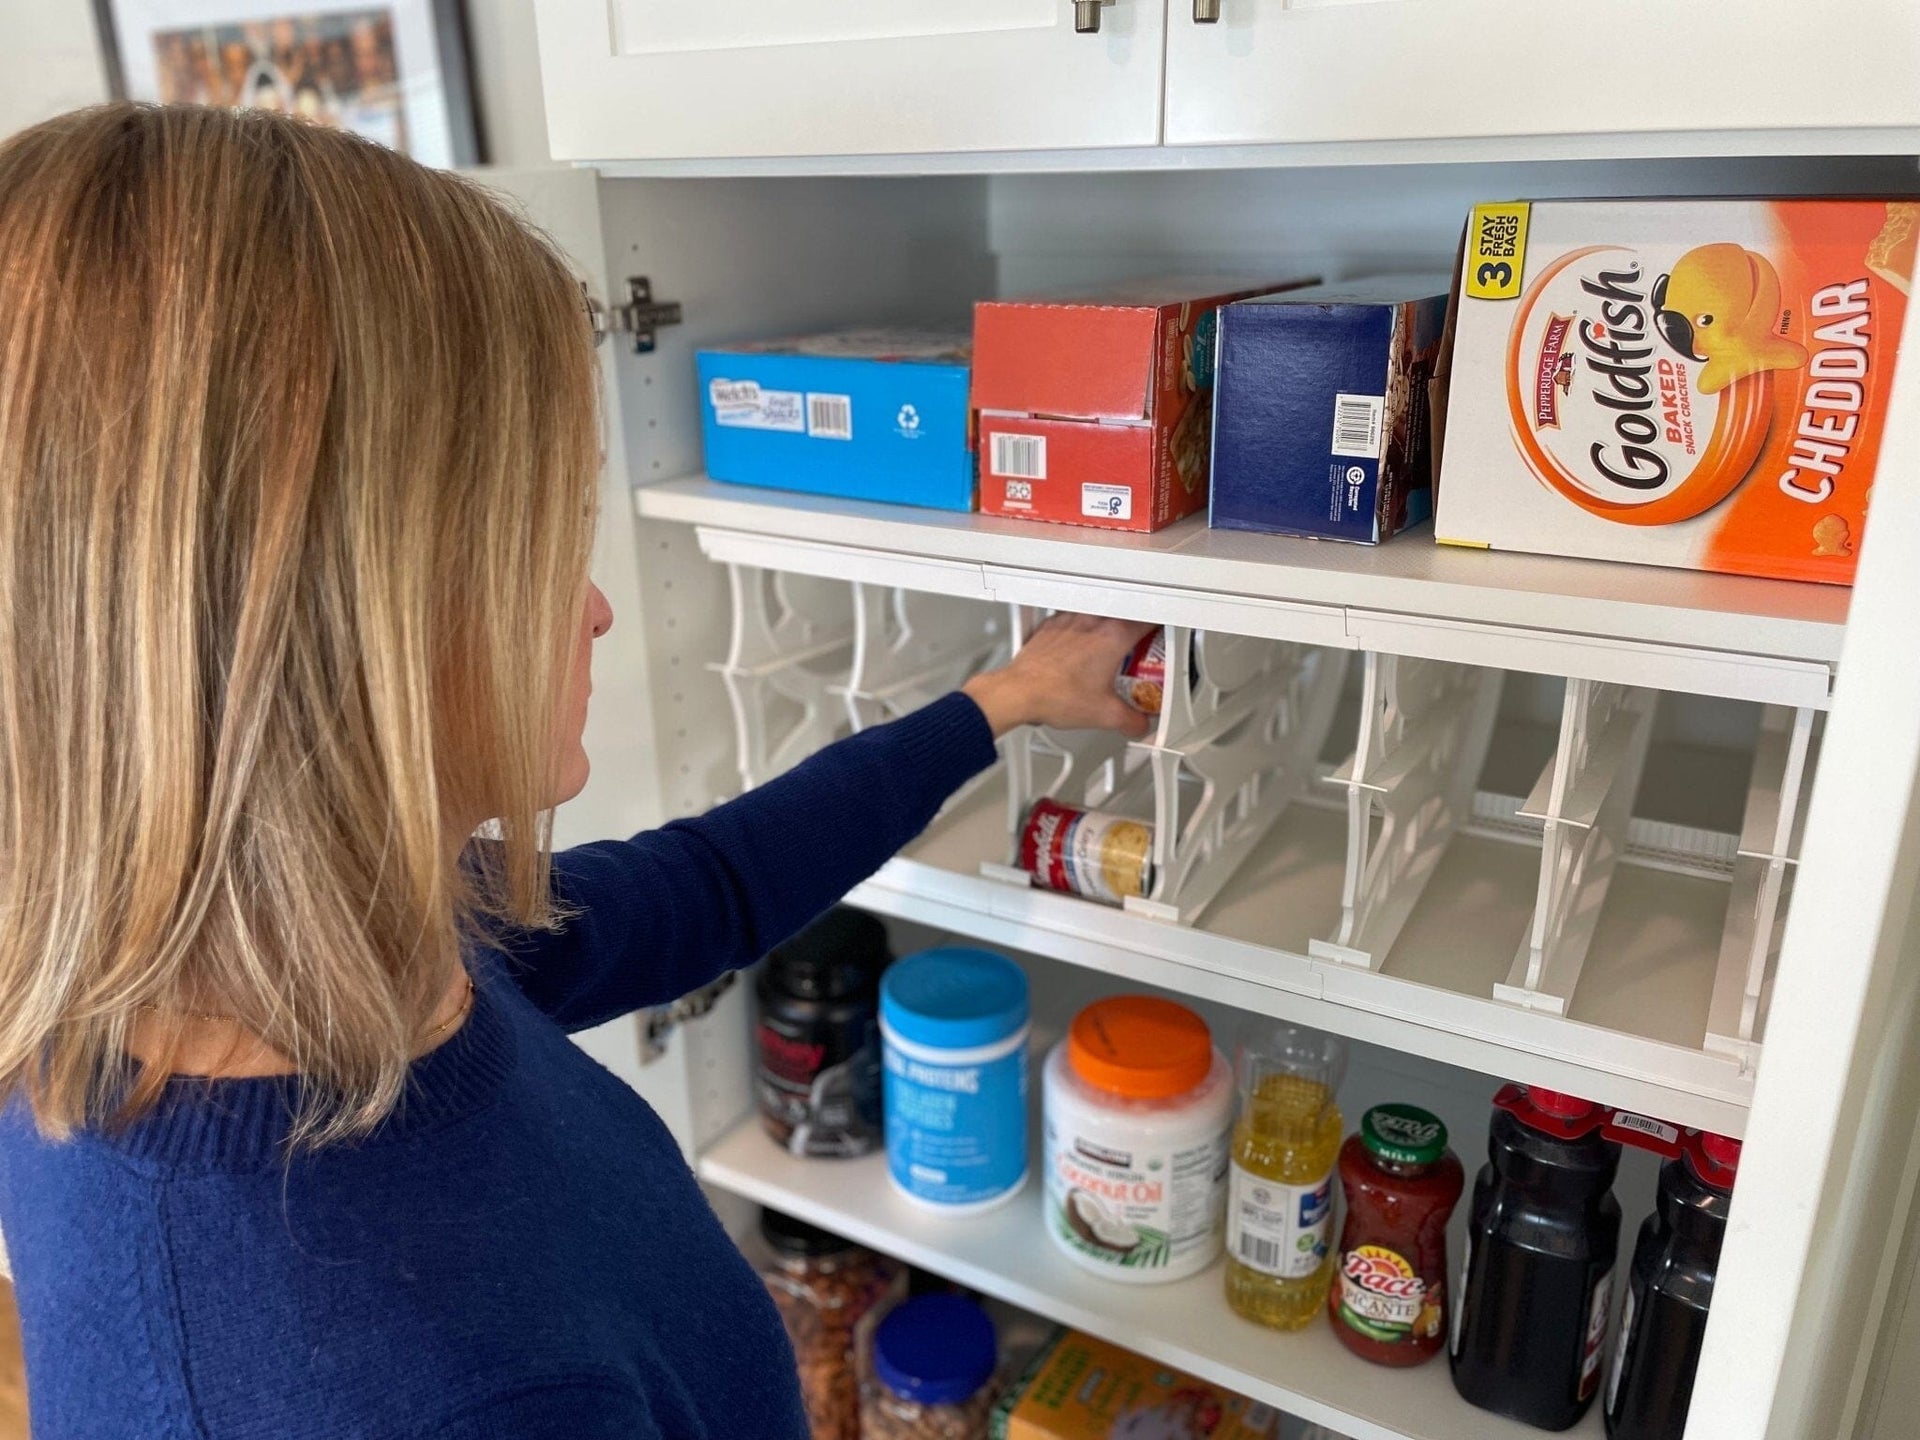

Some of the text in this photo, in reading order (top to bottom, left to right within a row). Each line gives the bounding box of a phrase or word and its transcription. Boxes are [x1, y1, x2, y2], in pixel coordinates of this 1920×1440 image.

[1480, 215, 1496, 256] STAY
[1492, 215, 1507, 257] FRESH
[1503, 215, 1519, 257] BAGS
[1477, 261, 1513, 288] 3
[1538, 324, 1565, 421] PEPPERIDGE FARM
[1778, 277, 1871, 503] CHEDDAR
[1657, 358, 1683, 444] BAKED
[1676, 363, 1696, 456] SNACK CRACKERS
[1379, 1147, 1417, 1163] MILD
[1132, 1181, 1163, 1203] Oil
[1345, 1287, 1416, 1317] PICANTE
